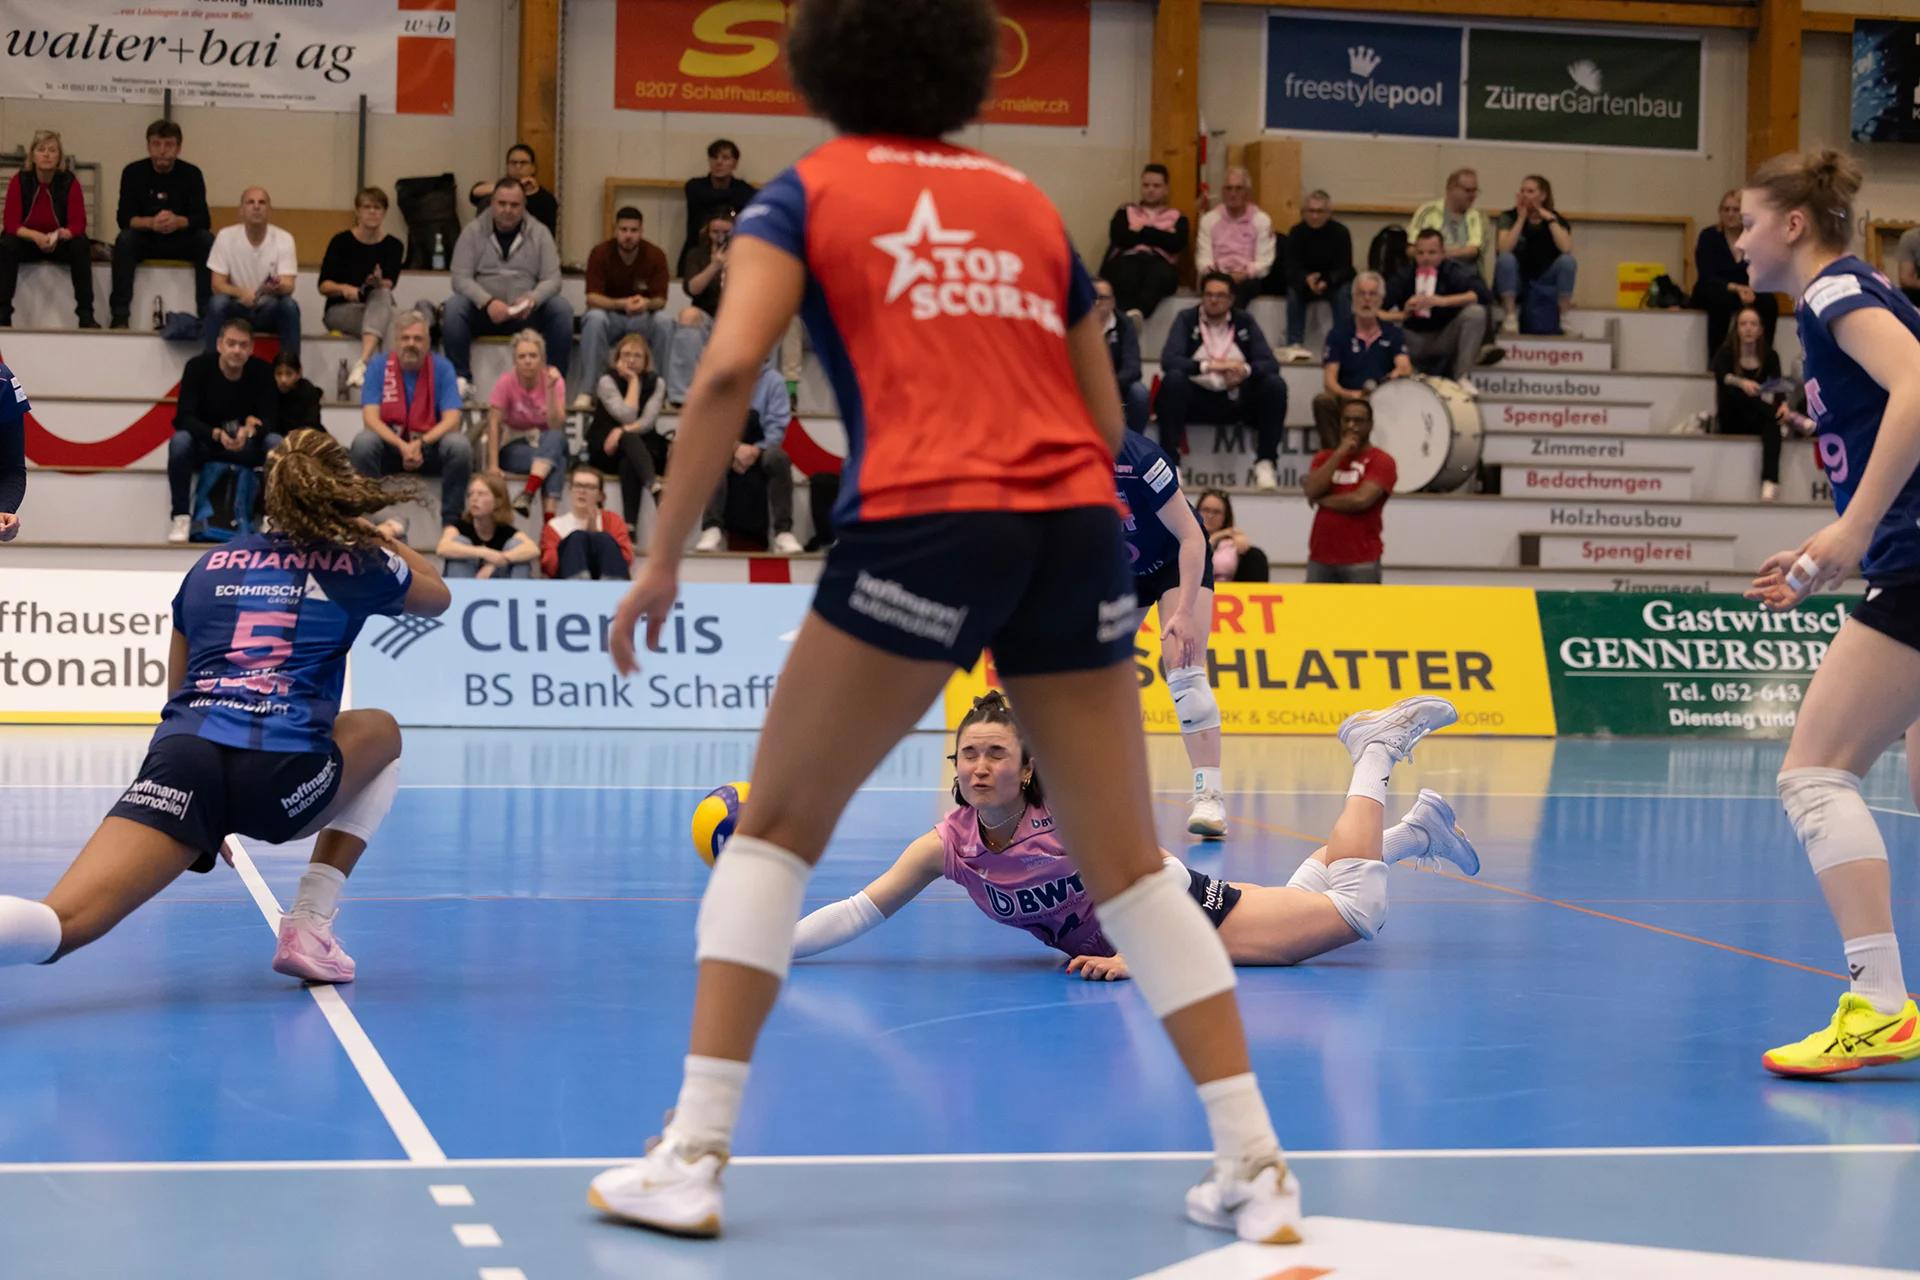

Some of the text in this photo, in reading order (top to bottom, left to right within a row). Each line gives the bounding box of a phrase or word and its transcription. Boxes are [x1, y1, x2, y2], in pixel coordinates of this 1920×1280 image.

[404, 17, 450, 32] w+b
[6, 24, 356, 83] walter+bai ag
[1285, 73, 1443, 108] freestylepool
[1485, 86, 1683, 119] ZürrerGartenbau
[931, 246, 1024, 284] TOP
[1475, 376, 1601, 396] Holzhausbau
[1503, 406, 1608, 427] Spenglerei
[1531, 440, 1625, 457] Zimmerei
[1526, 471, 1662, 494] Bedachungen
[1550, 509, 1682, 528] Holzhausbau
[206, 549, 354, 576] BRIANNA
[1581, 541, 1692, 562] Spenglerei
[215, 585, 303, 597] ECKHIRSCH
[0, 600, 168, 635] ffhauser
[225, 611, 298, 669] 5
[0, 647, 166, 687] tonalb
[465, 673, 782, 708] BS Bank Schaff
[1663, 682, 1706, 702] Tel.
[1248, 709, 1262, 726] &
[1669, 708, 1796, 729] Dienstag und
[1014, 870, 1085, 915] BWT
